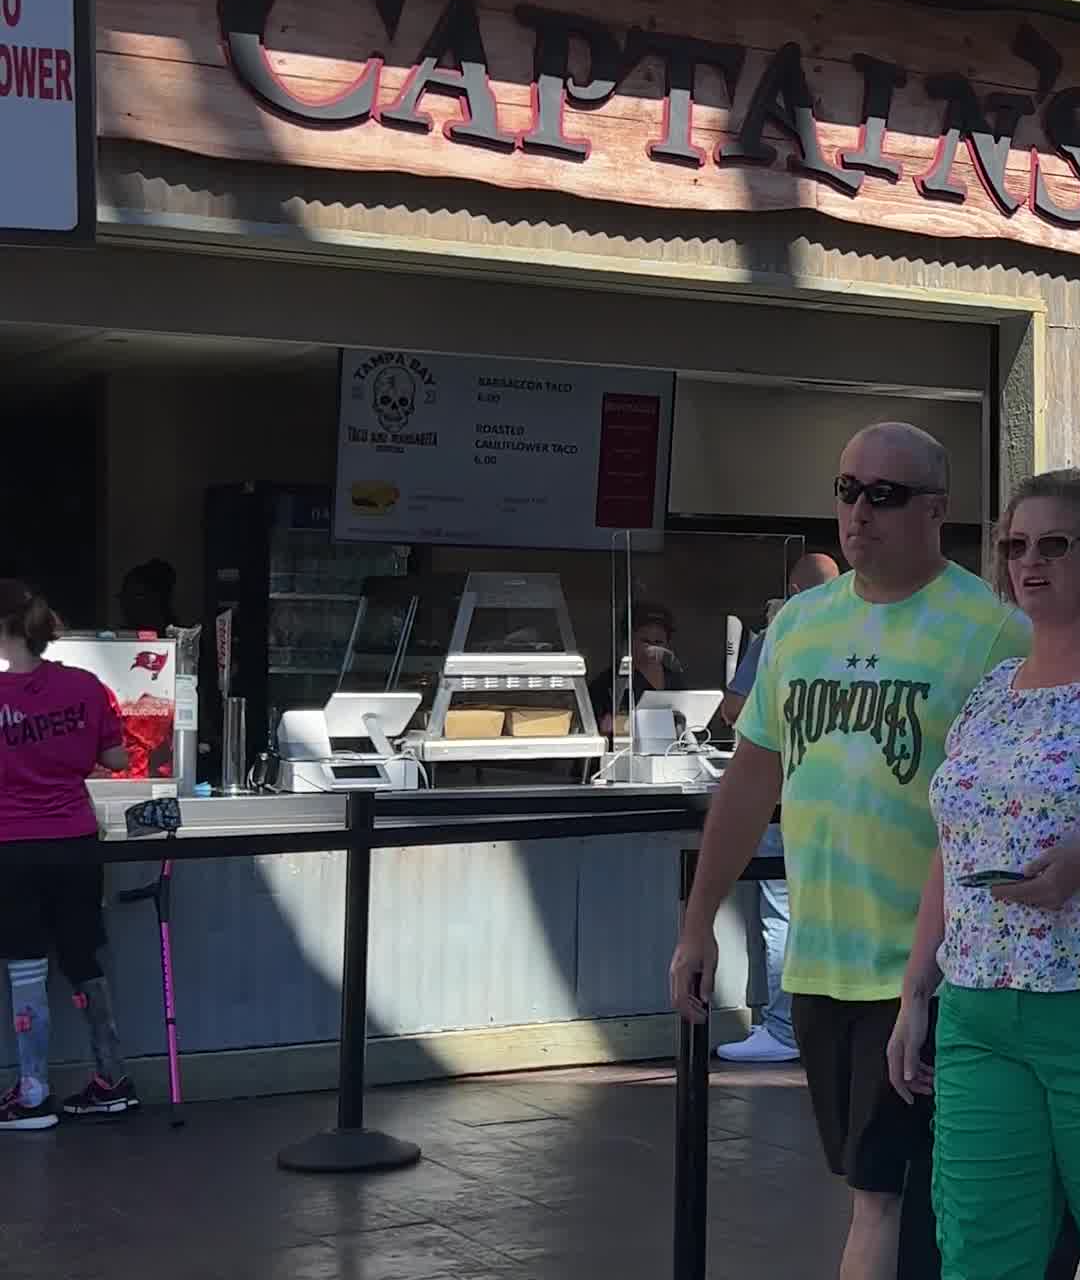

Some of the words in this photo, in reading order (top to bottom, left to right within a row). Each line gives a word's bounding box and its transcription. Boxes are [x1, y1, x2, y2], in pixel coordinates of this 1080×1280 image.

[353, 352, 405, 381] TAMPA
[409, 358, 437, 385] BAY
[545, 381, 573, 393] TACO
[474, 423, 525, 436] ROASTED
[473, 439, 549, 453] CAULIFLOWER
[551, 442, 579, 455] TACO
[5, 699, 89, 746] CAPES!
[784, 676, 932, 786] ROWDIES
